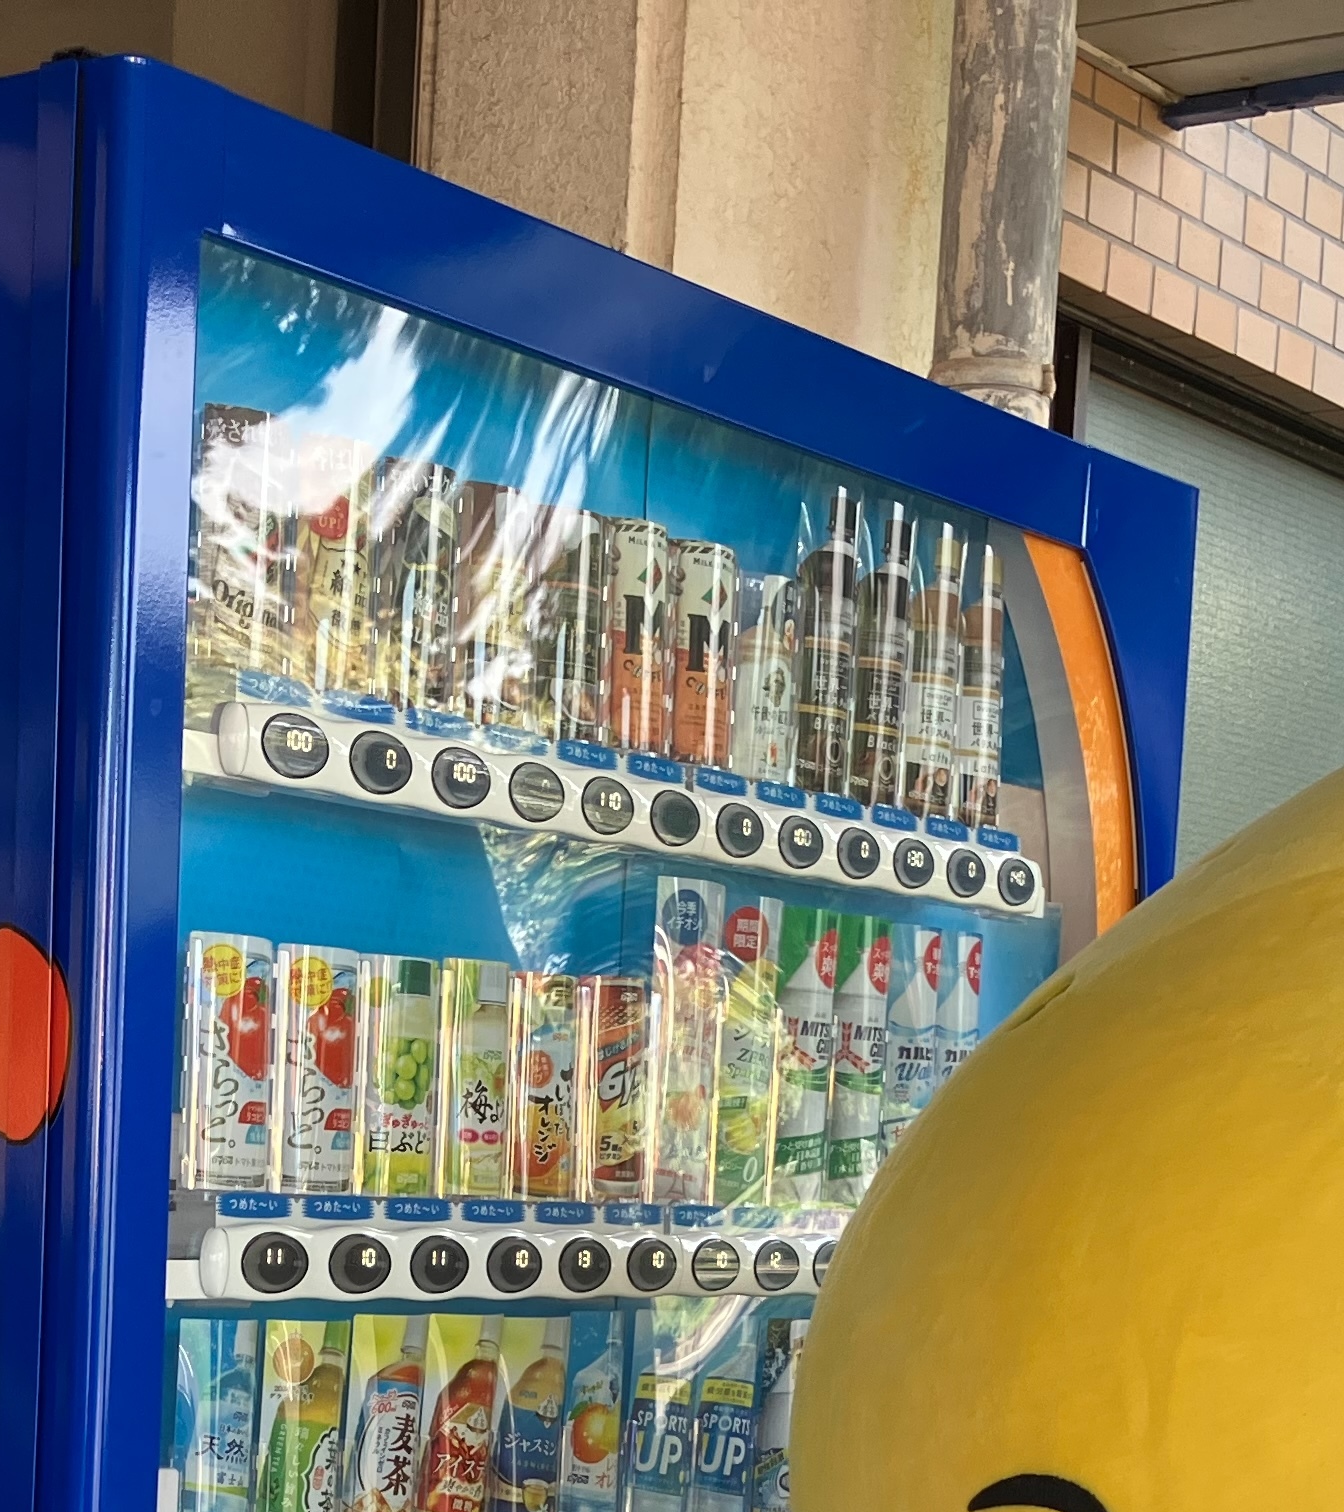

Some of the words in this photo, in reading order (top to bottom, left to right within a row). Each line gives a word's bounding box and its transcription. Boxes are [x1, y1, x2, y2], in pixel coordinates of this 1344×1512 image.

[286, 729, 313, 753] 100
[453, 762, 477, 785] 100
[228, 1197, 281, 1213] つめた〜い
[312, 1199, 363, 1215] つめた〜い
[394, 1201, 442, 1217] つめた〜い
[470, 1202, 516, 1218] つめた〜い
[637, 1409, 689, 1435] SPORTS
[702, 1412, 751, 1436] SPORTS
[381, 1413, 416, 1496] 麦茶
[635, 1430, 683, 1475] UP
[700, 1432, 747, 1476] UP
